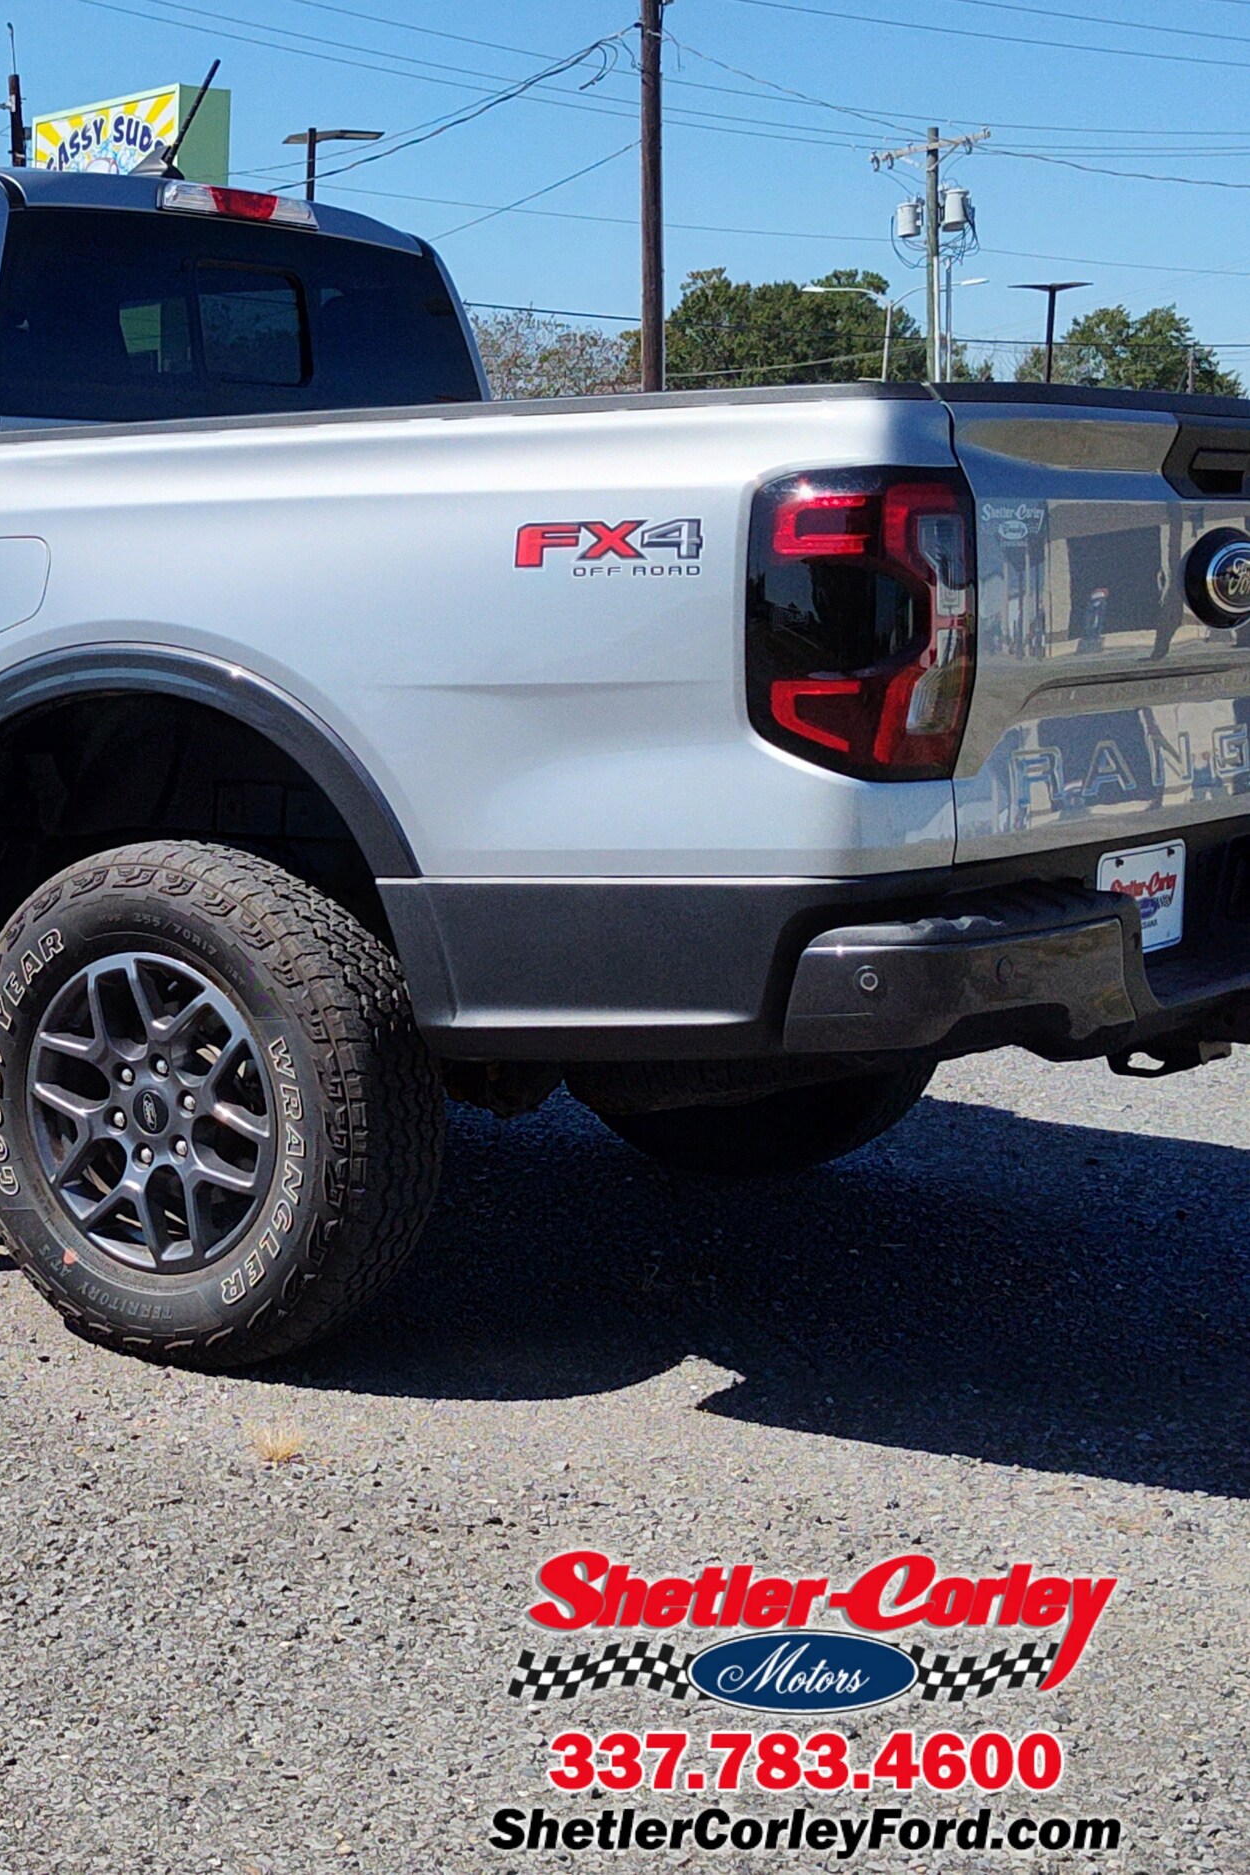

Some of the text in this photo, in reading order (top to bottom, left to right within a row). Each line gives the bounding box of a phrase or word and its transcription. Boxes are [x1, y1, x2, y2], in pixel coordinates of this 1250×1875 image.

[113, 115, 165, 153] SUD
[515, 518, 703, 568] FX4
[572, 565, 701, 577] OFF ROAD
[220, 1036, 307, 1305] WRANGLER
[75, 1280, 174, 1320] TERRITORY
